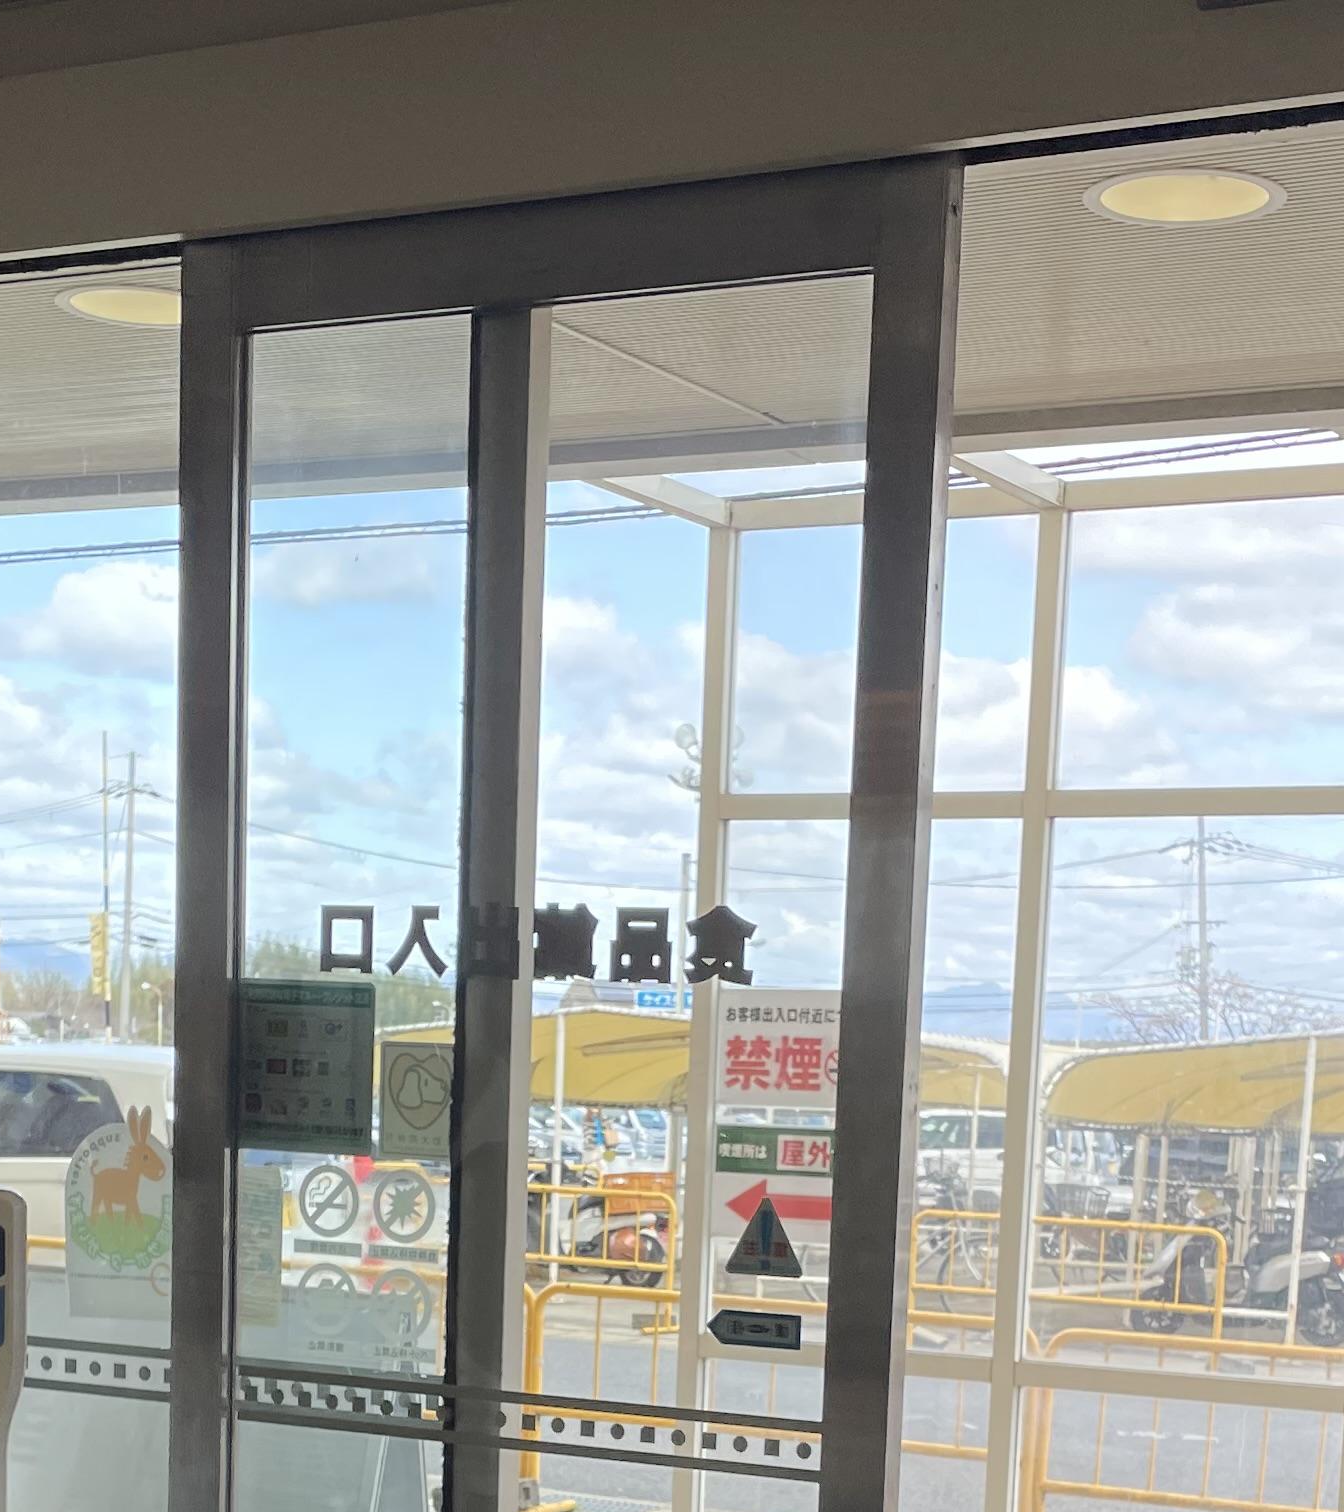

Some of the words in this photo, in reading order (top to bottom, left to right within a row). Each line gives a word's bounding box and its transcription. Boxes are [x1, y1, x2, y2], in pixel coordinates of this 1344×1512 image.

[725, 1006, 841, 1025] お客様出入口付近に
[724, 1034, 823, 1092] 禁煙
[780, 1139, 831, 1169] 屋外
